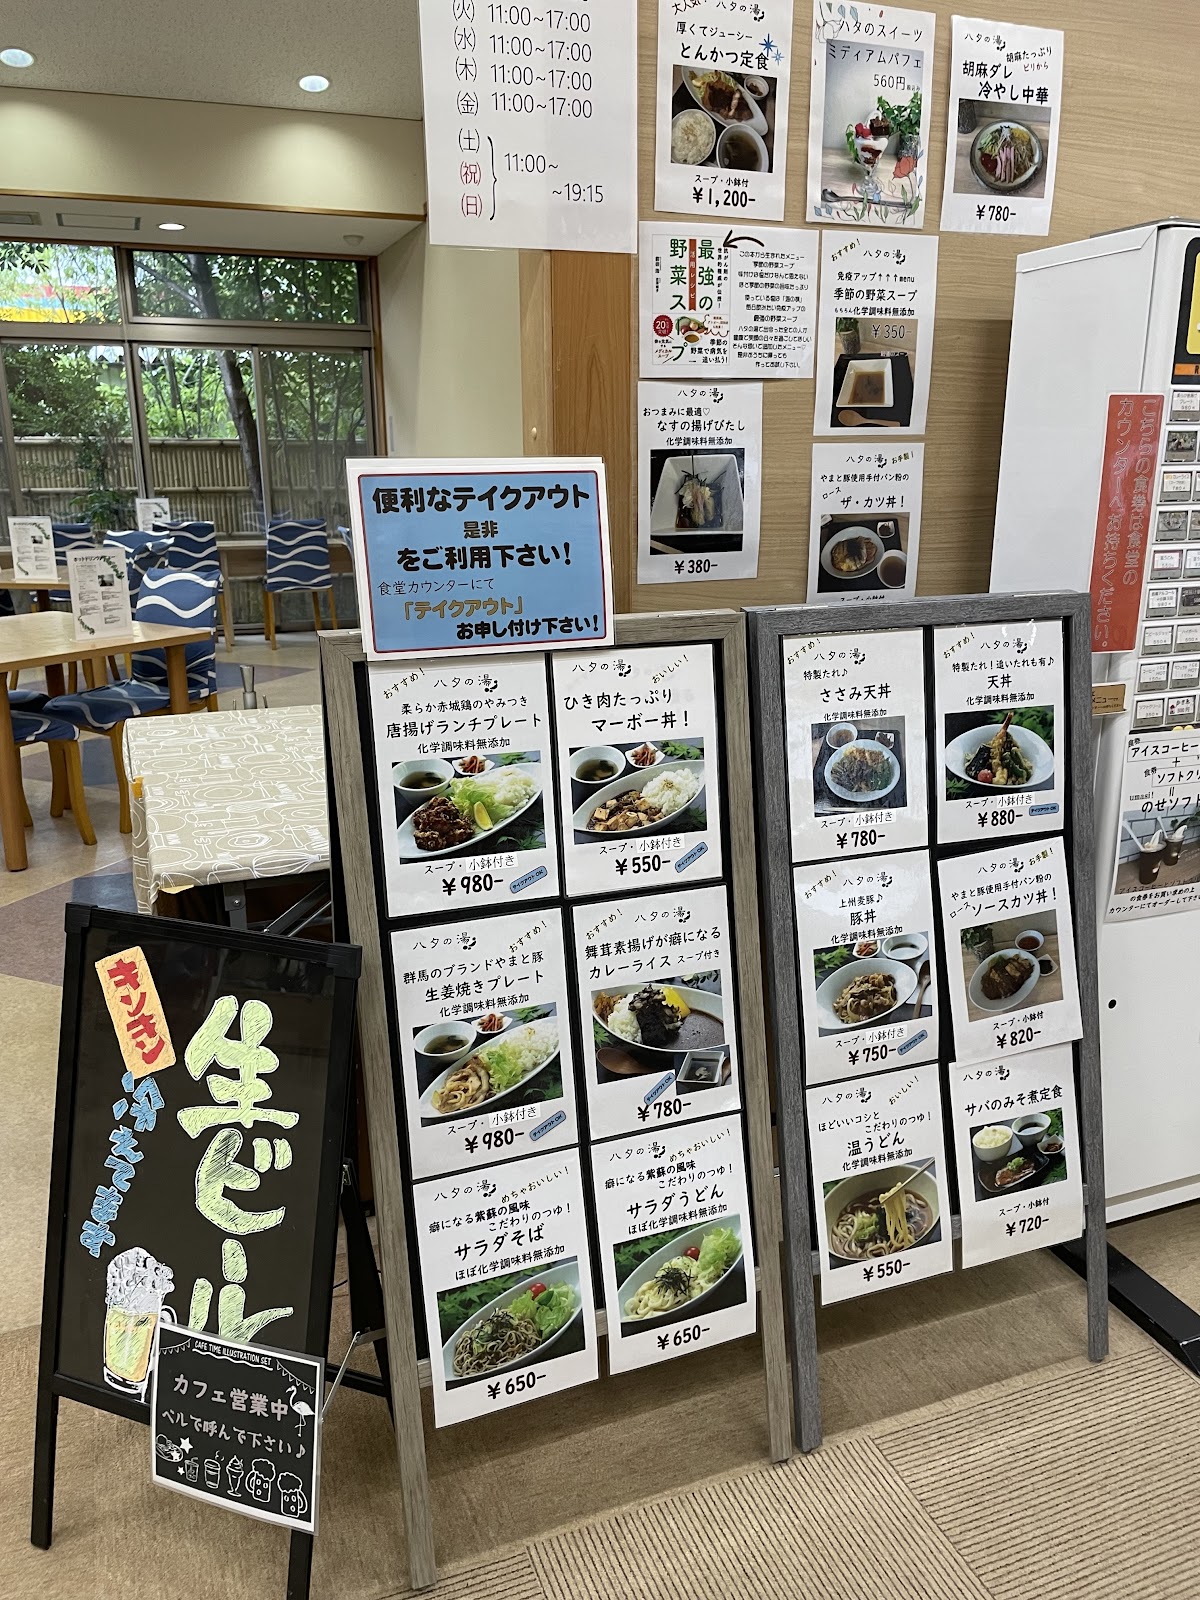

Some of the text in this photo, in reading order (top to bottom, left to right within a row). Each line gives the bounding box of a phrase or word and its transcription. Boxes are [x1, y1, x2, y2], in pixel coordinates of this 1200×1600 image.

[676, 21, 753, 41] 厚くてジューシー
[840, 20, 923, 42] ハタのスイーツ
[681, 42, 769, 70] とんかつ定食
[827, 44, 922, 69] ミディアムパフェ
[963, 60, 1013, 79] 胡麻ダレ
[873, 74, 906, 91] 560円
[978, 81, 1049, 105] 冷やし中華
[834, 288, 918, 301] 季節の野菜スープ
[657, 419, 745, 432] なすの揚げびたし
[666, 437, 733, 446] 化学調味料無添加
[372, 484, 590, 514] 便利なテイクアウト
[463, 521, 498, 539] 是非
[397, 542, 571, 572] をご利用下さい!
[378, 578, 494, 596] 食堂カウンターにて
[404, 596, 523, 620] 「テイクアウト」
[456, 614, 599, 640] お申し付け下さい!
[814, 648, 864, 663] ハタの湯
[980, 638, 1026, 652] ハタの湯
[572, 659, 630, 675] ハタの湯
[383, 667, 426, 699] おすすめ!
[433, 674, 496, 691] ハタの湯
[987, 674, 1012, 689] 天丼
[563, 689, 673, 710] ひき肉たっぷり
[820, 683, 892, 703] ささみ天丼
[966, 692, 1035, 706] 化学調味料無添加
[401, 695, 528, 716] 柔らか赤城鶏のやみつき
[823, 708, 888, 722] 化学調味料無添加
[387, 713, 542, 739] 唐揚げランチプレート
[591, 710, 689, 732] マーボー丼!
[418, 737, 511, 755] 化学調味料無添加
[1131, 742, 1199, 758] アイスコーヒー
[978, 858, 1023, 874] ハタの湯
[842, 871, 890, 887] ハタの湯
[586, 908, 623, 940] おすすめ!
[634, 907, 688, 923] ハタの湯
[850, 909, 877, 926] 豚丼
[413, 932, 474, 950] ハタの湯
[509, 920, 548, 953] おすすめ!
[585, 926, 721, 960] 舞茸素揚げが癖になる
[831, 925, 903, 945] 化学調味料無添加
[403, 951, 544, 984] 群馬のブランドやまと豚
[590, 949, 720, 980] カレーライス スープ付き
[425, 969, 544, 1003] 生姜焼きプレート
[440, 993, 530, 1018] 化学調味料無添加
[963, 1066, 1008, 1081] ハタの湯
[822, 1087, 869, 1104] ハタの湯
[964, 1084, 1063, 1117] サバのみそ煮定食
[818, 1111, 880, 1132] ほどいいコシと
[610, 1143, 664, 1161] ハタの湯
[847, 1131, 905, 1157] 温うどん
[177, 995, 300, 1345] 生ビール
[842, 1148, 913, 1171] 化学調味料無添加
[605, 1159, 696, 1189] 癖になる紫蘇の風味
[434, 1179, 494, 1201] ハタの湯
[626, 1183, 724, 1220] サラダうどん
[429, 1199, 531, 1234] 癖になる紫蘇の風味
[628, 1203, 728, 1235] ほぼ化学調味料無添加
[454, 1224, 545, 1261] サラダそば
[455, 1244, 565, 1281] ほぼ化学調味料無添加
[194, 1340, 272, 1366] CAFE TIME ILLUSTRATION SET
[173, 1373, 289, 1422] カフェ営業中
